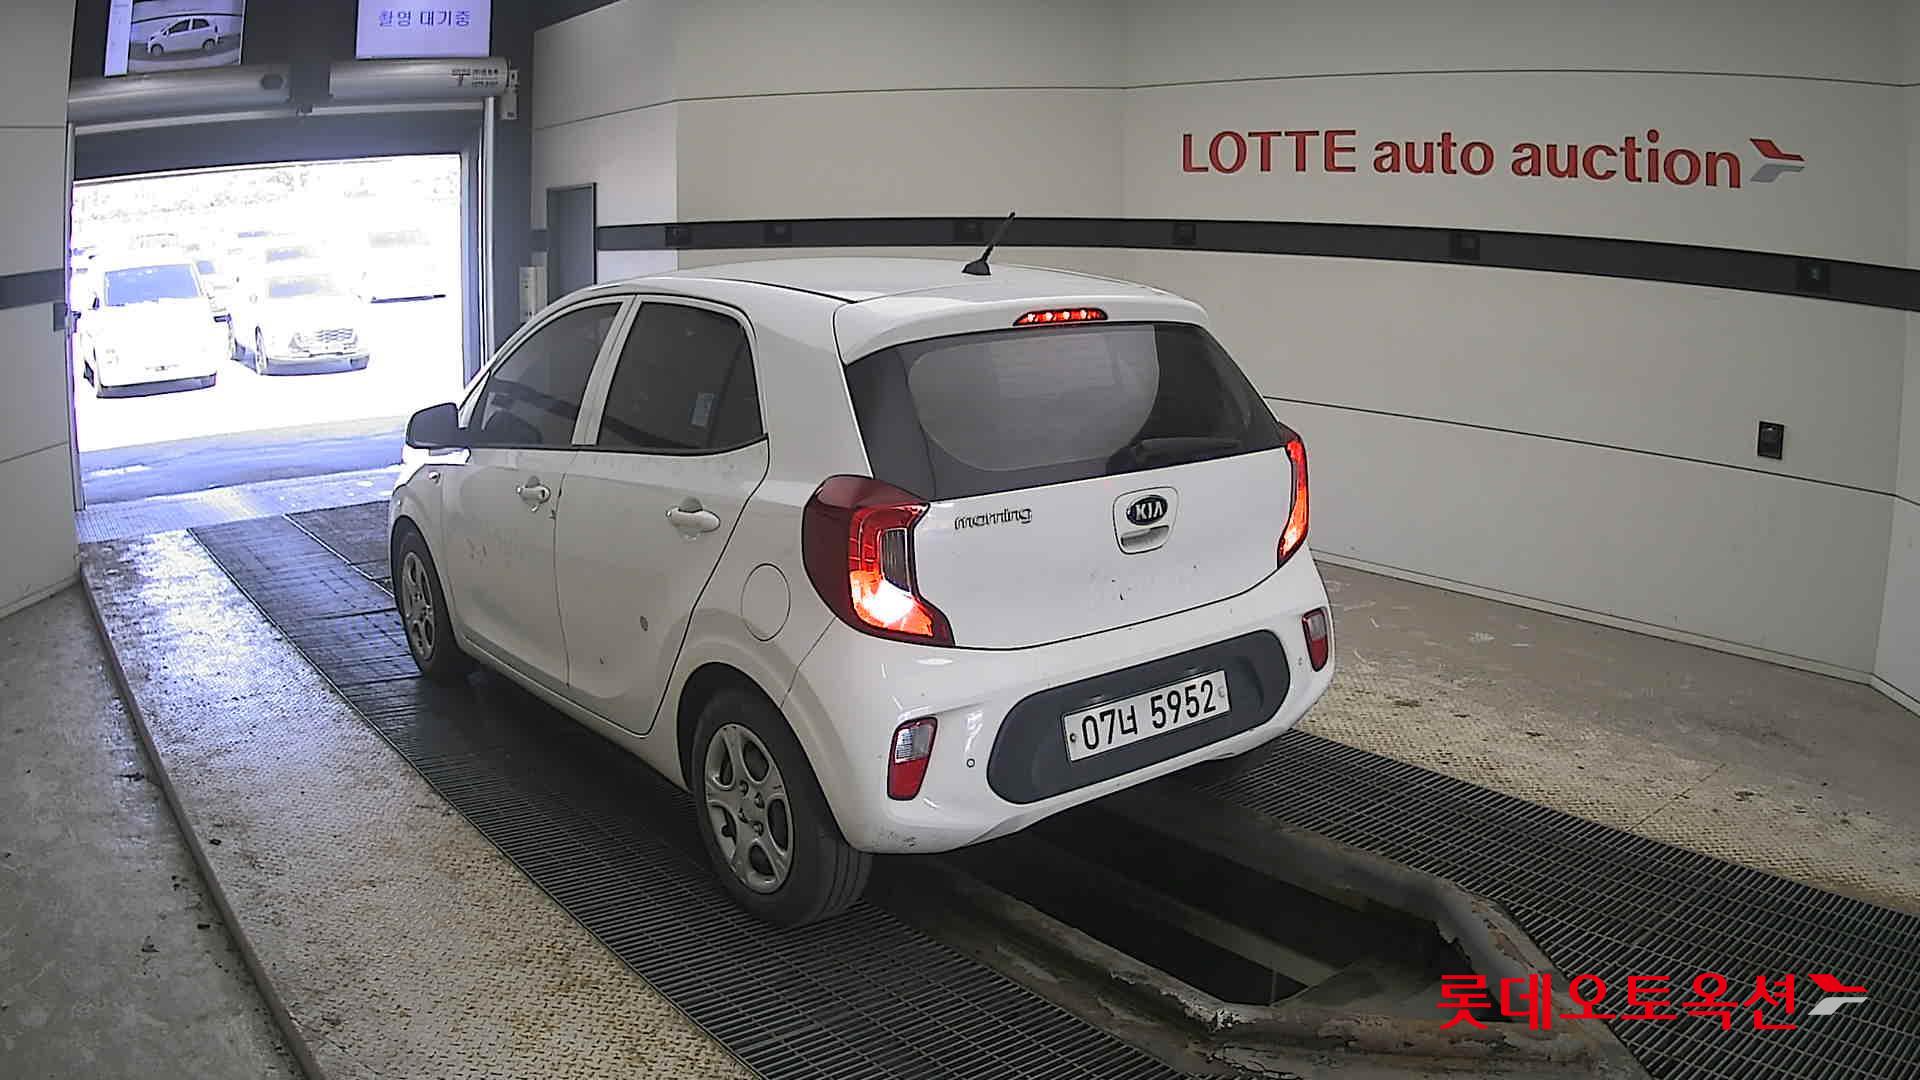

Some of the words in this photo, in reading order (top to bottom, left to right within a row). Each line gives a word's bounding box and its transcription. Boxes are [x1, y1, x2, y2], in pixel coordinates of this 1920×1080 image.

[420, 10, 470, 26] 대기중
[1182, 129, 1356, 173] LOTTE
[1373, 131, 1495, 176] auto
[1511, 129, 1742, 188] auction
[954, 507, 1032, 531] morning
[1134, 500, 1164, 521] KIA
[1081, 705, 1138, 750] 07너
[1150, 679, 1217, 729] 5952
